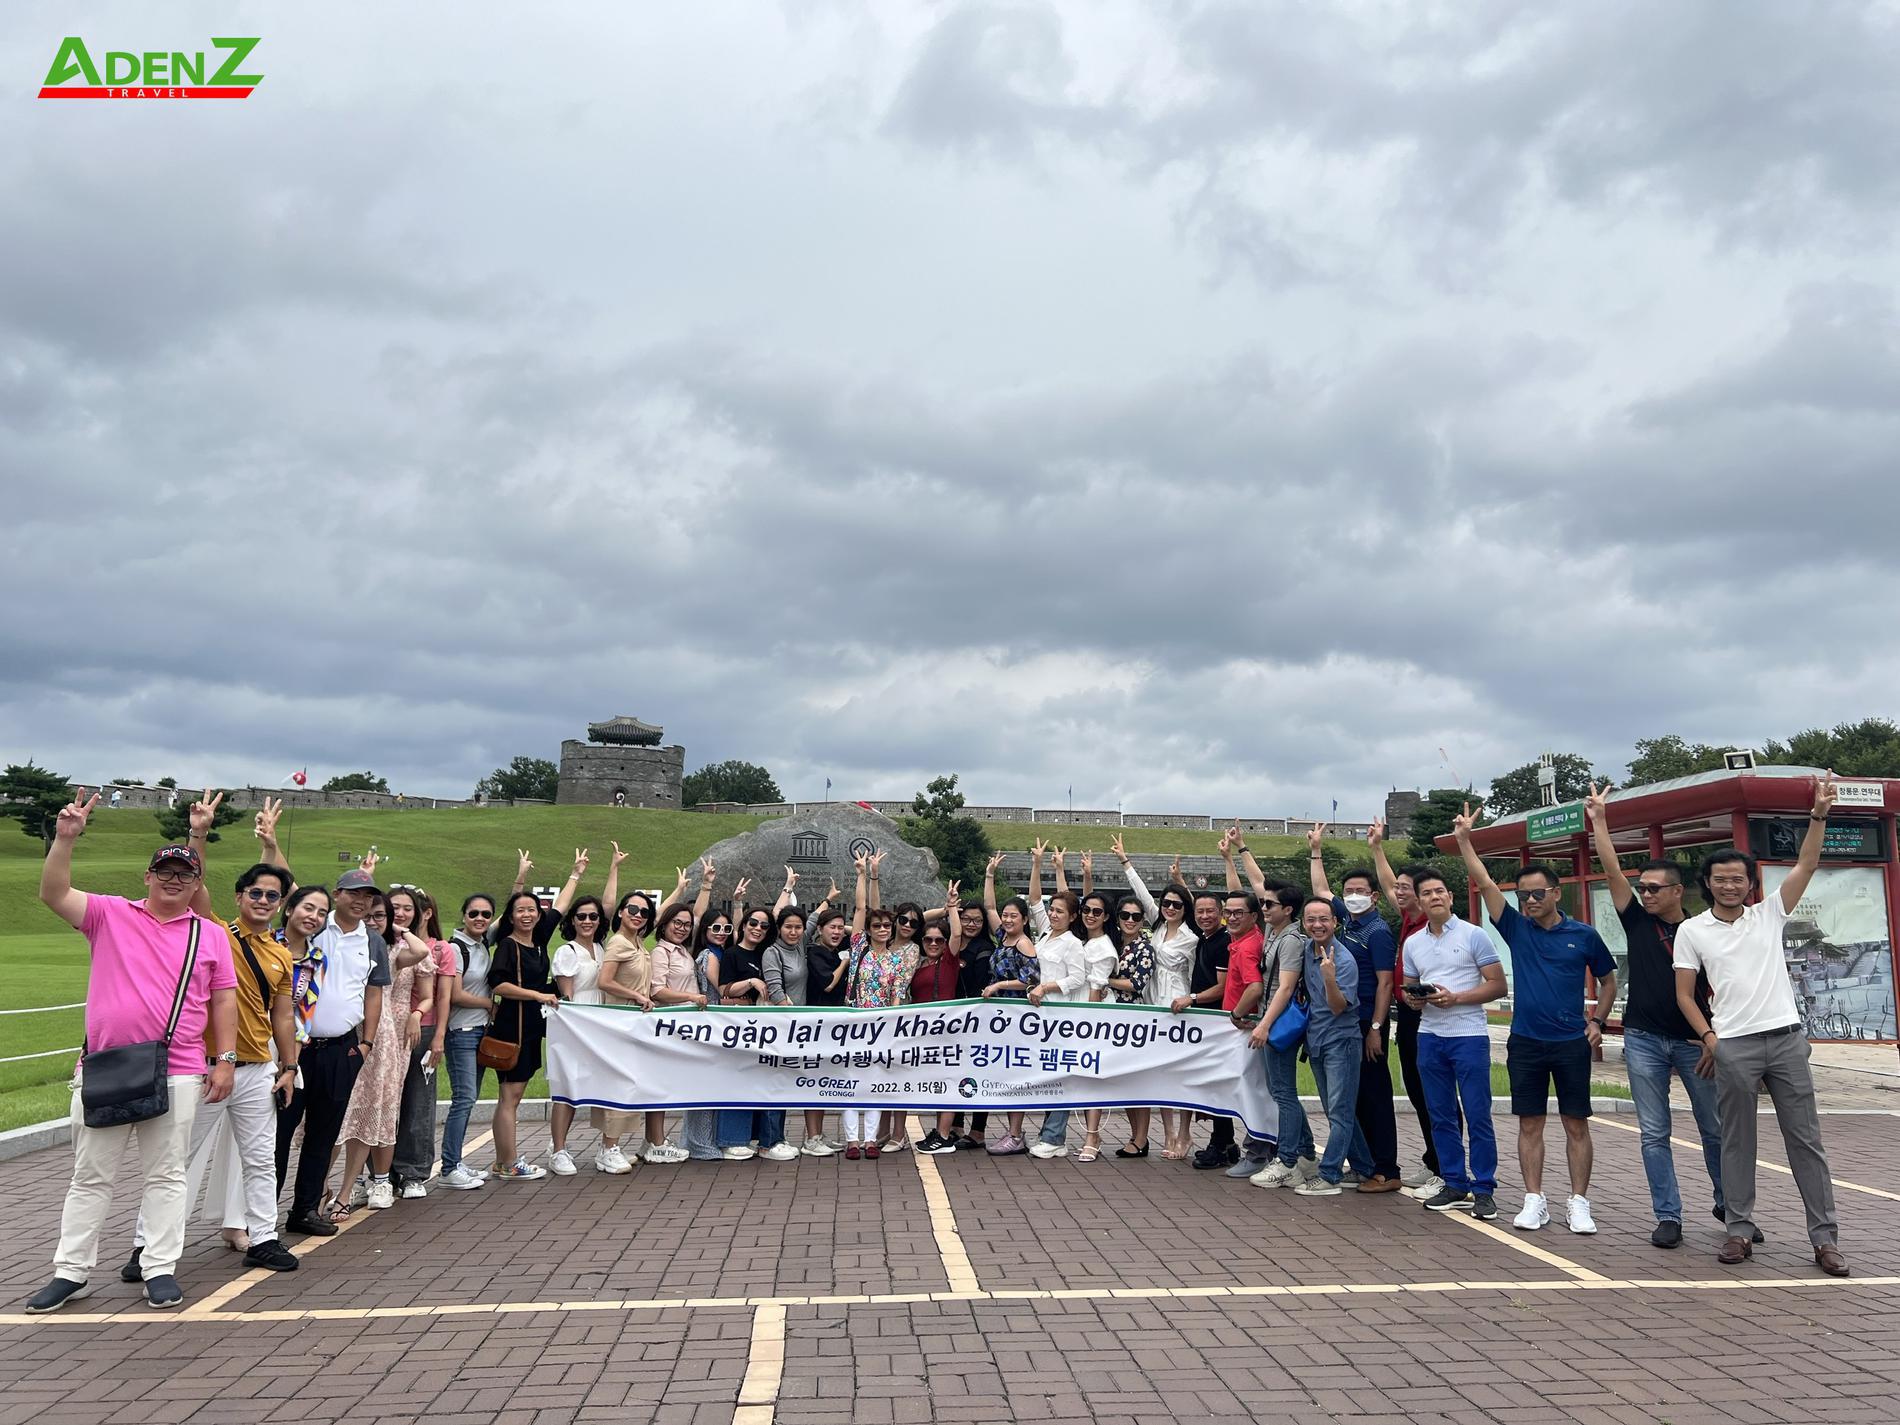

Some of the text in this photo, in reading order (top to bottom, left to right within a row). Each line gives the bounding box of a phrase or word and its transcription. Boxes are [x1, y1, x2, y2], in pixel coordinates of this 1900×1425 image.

[792, 839, 827, 857] UNESCO
[654, 1010, 1203, 1049] Hẹn gặp lại quý khách ở Gyeonggi-do
[831, 1049, 895, 1069] 여행사
[901, 1044, 963, 1067] 대표단
[970, 1044, 1032, 1069] 경기도
[1039, 1048, 1101, 1074] 팸투어
[818, 1076, 860, 1090] GREAT
[870, 1081, 948, 1094] 2022. 8. 15(월)
[818, 1090, 855, 1098] GYEONGGI
